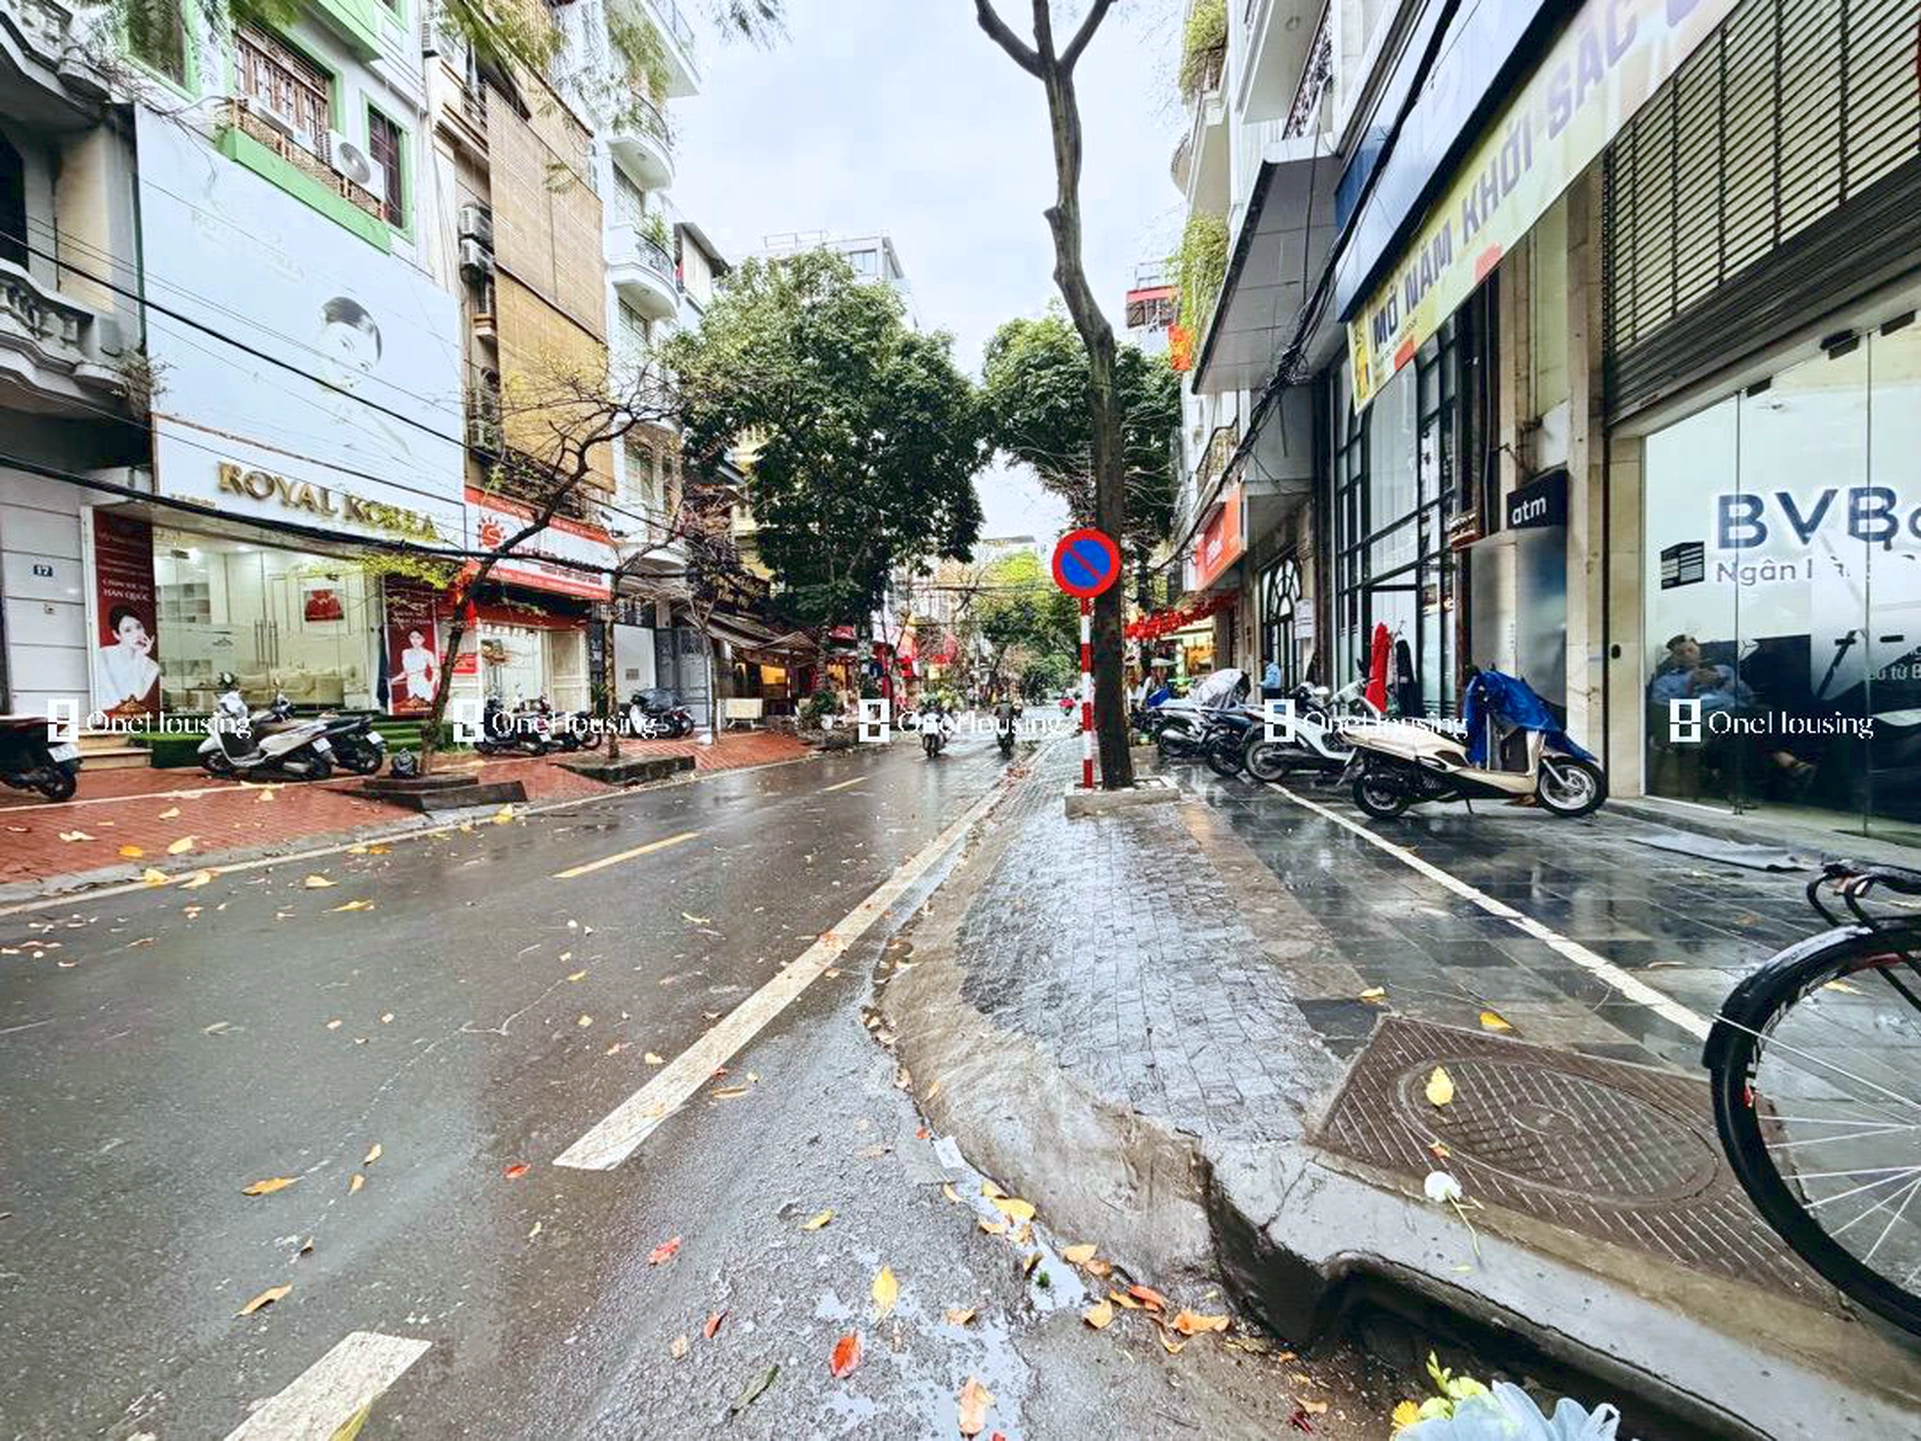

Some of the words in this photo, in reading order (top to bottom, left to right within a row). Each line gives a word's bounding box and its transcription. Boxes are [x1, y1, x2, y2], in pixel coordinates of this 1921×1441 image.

[217, 461, 338, 517] ROYAL
[1512, 497, 1546, 525] atm
[1716, 558, 1797, 586] Ngân
